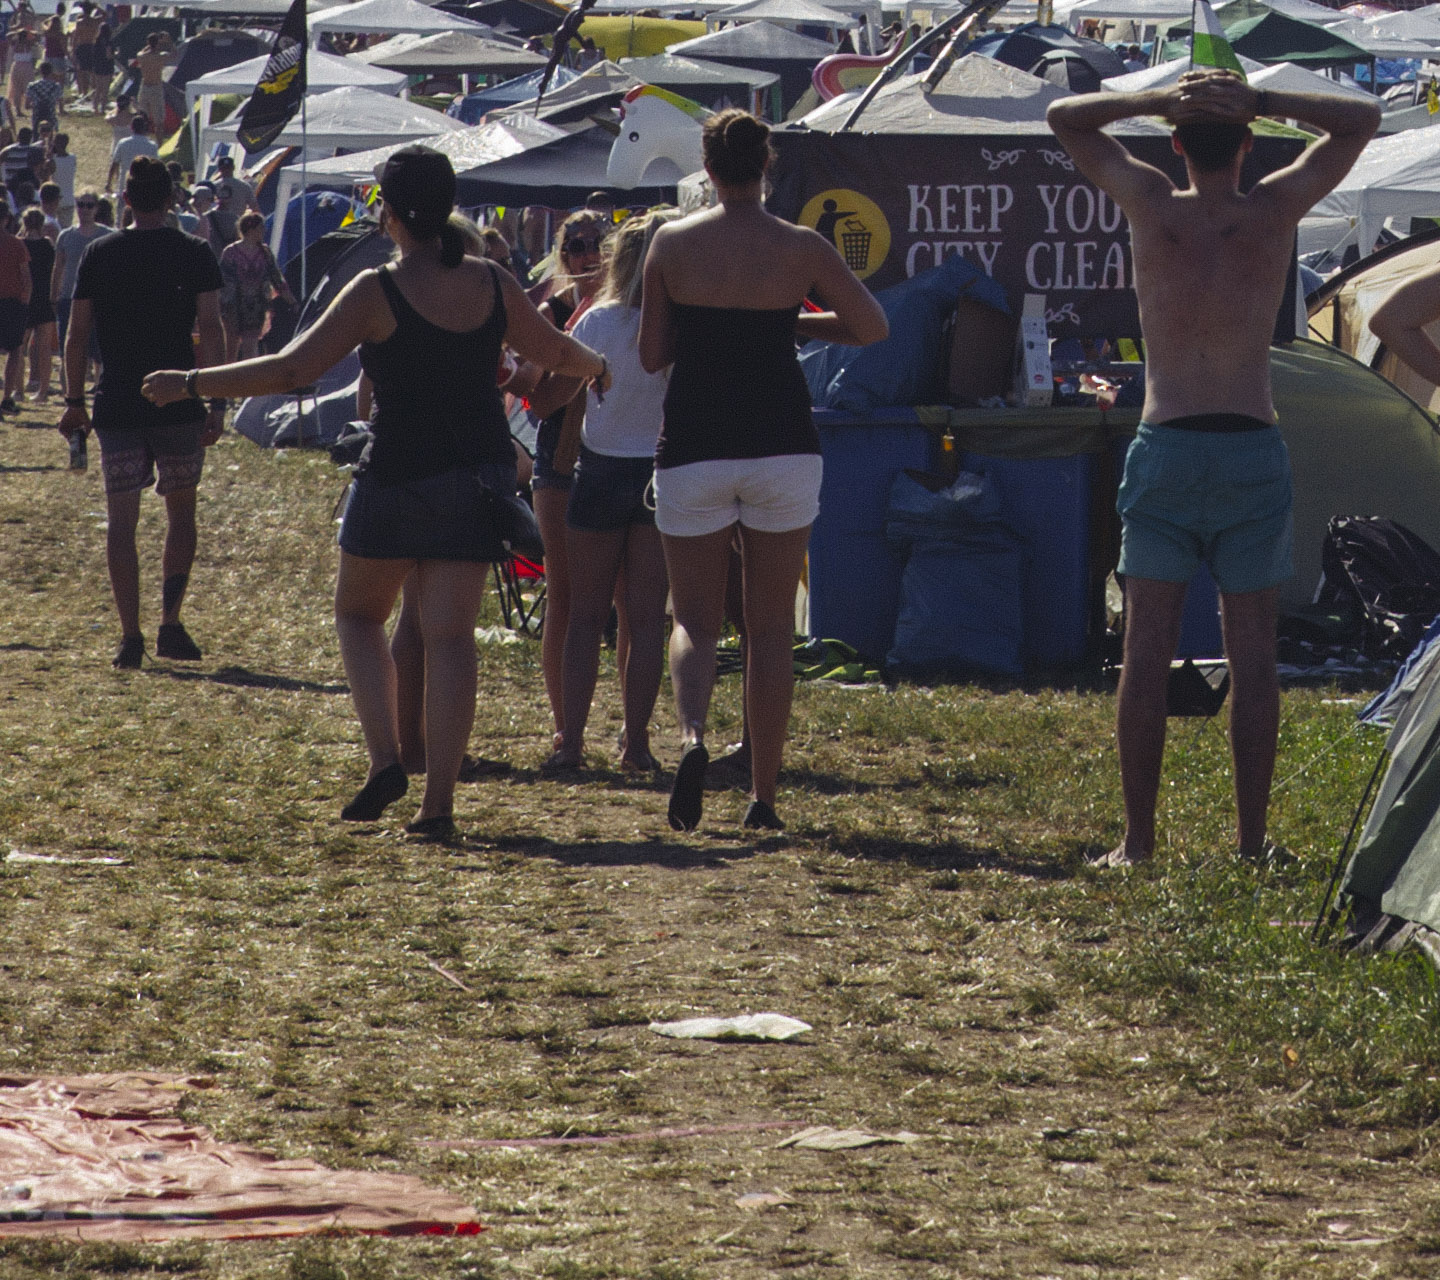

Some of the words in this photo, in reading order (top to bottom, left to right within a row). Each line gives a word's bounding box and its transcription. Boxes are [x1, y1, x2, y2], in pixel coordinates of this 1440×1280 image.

[907, 184, 1014, 233] KEEP
[1037, 185, 1133, 234] YOU
[1025, 241, 1137, 290] CLEA
